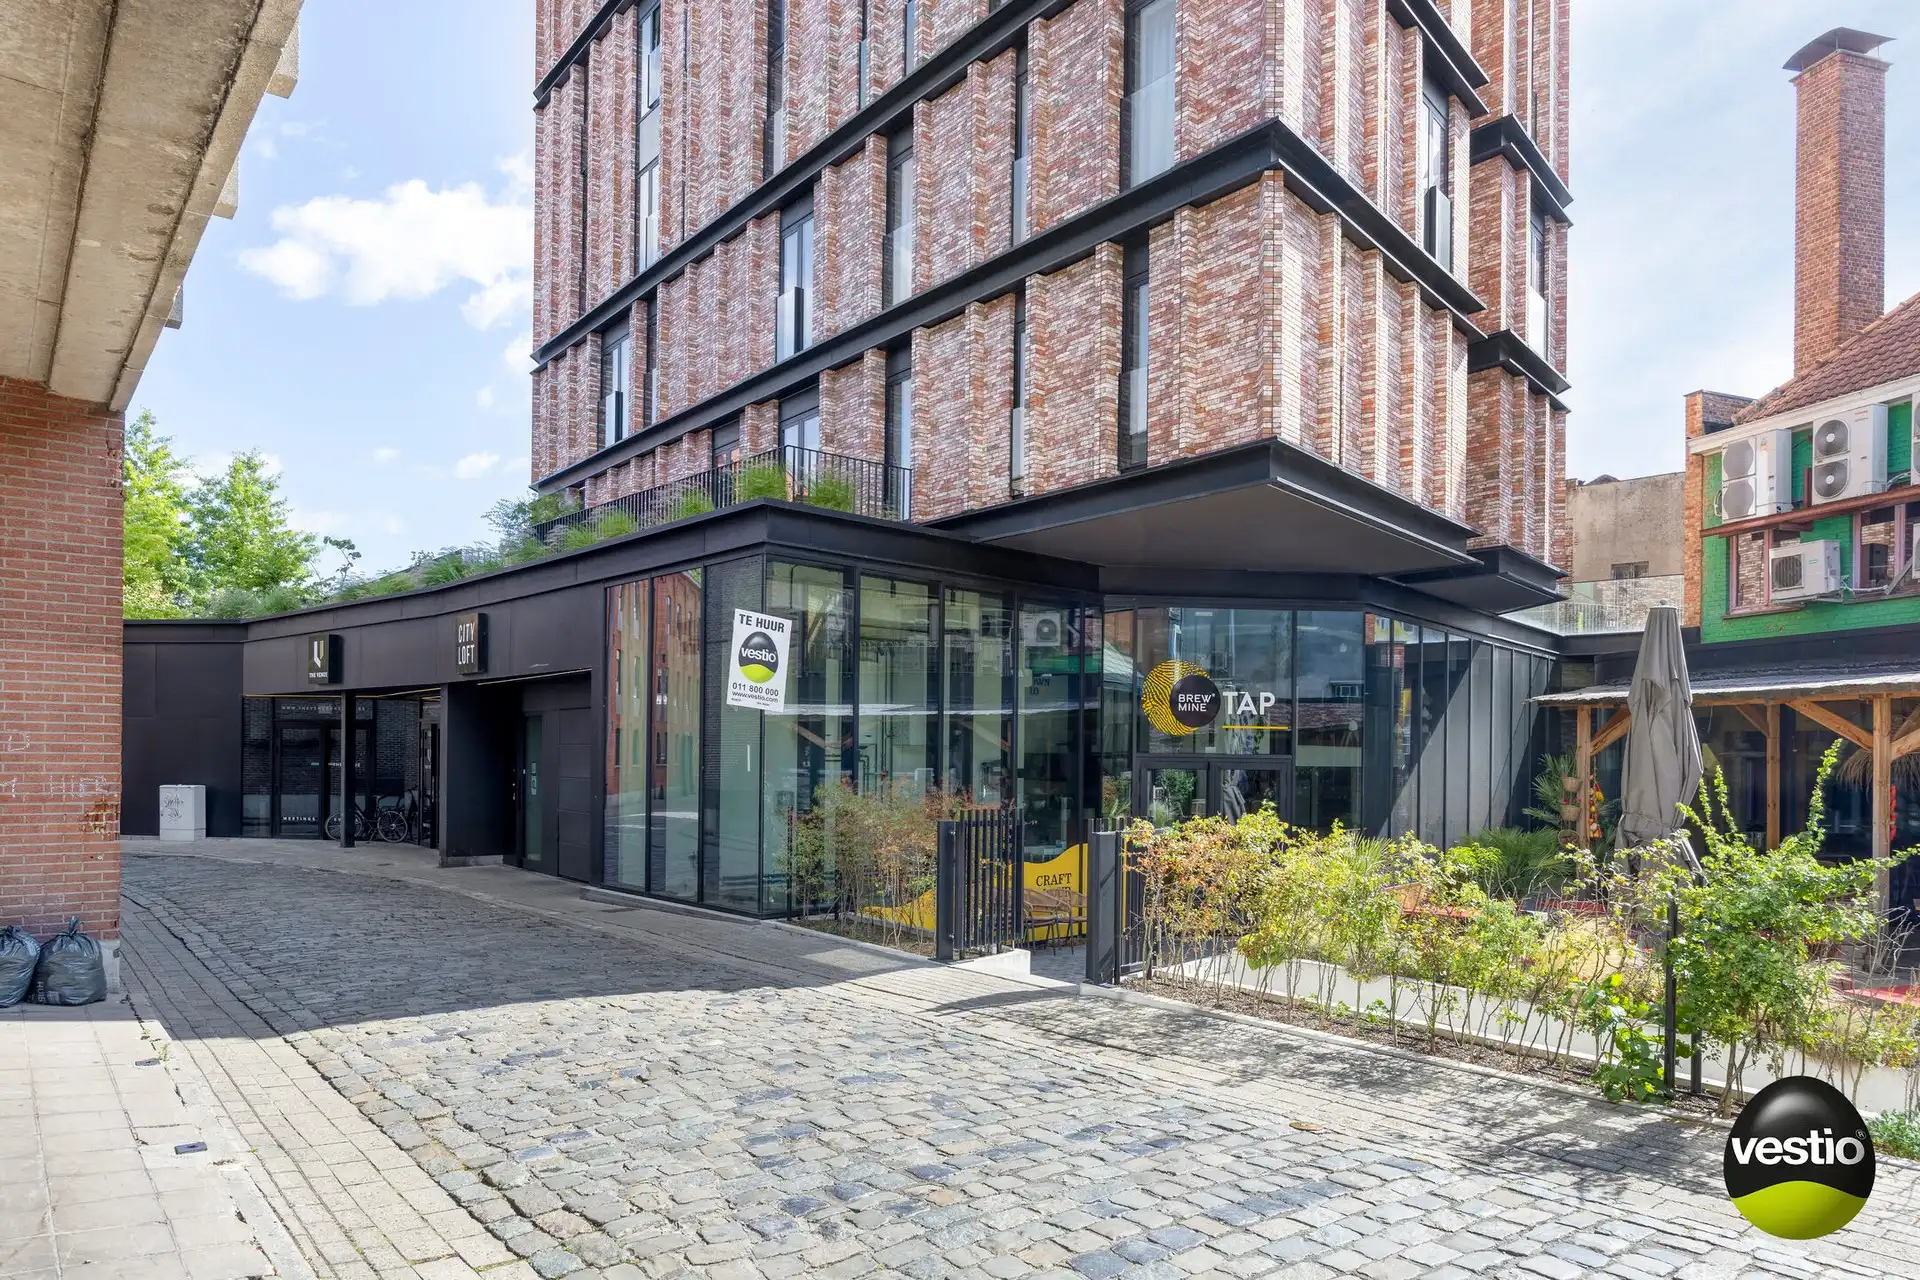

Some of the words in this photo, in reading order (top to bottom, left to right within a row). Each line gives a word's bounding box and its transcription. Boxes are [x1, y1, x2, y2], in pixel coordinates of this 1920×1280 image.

[739, 613, 753, 626] TE
[755, 617, 785, 633] HUUR
[458, 622, 475, 643] CITY
[458, 644, 475, 665] LOFT
[741, 647, 777, 663] vestio
[731, 691, 779, 703] www.vestio.com
[732, 682, 746, 691] 011
[748, 684, 763, 694] 800
[765, 687, 779, 697] 000
[1178, 694, 1212, 703] BREW
[1222, 691, 1276, 716] TAP
[1178, 703, 1207, 712] MINE
[1035, 873, 1072, 887] CRAFT
